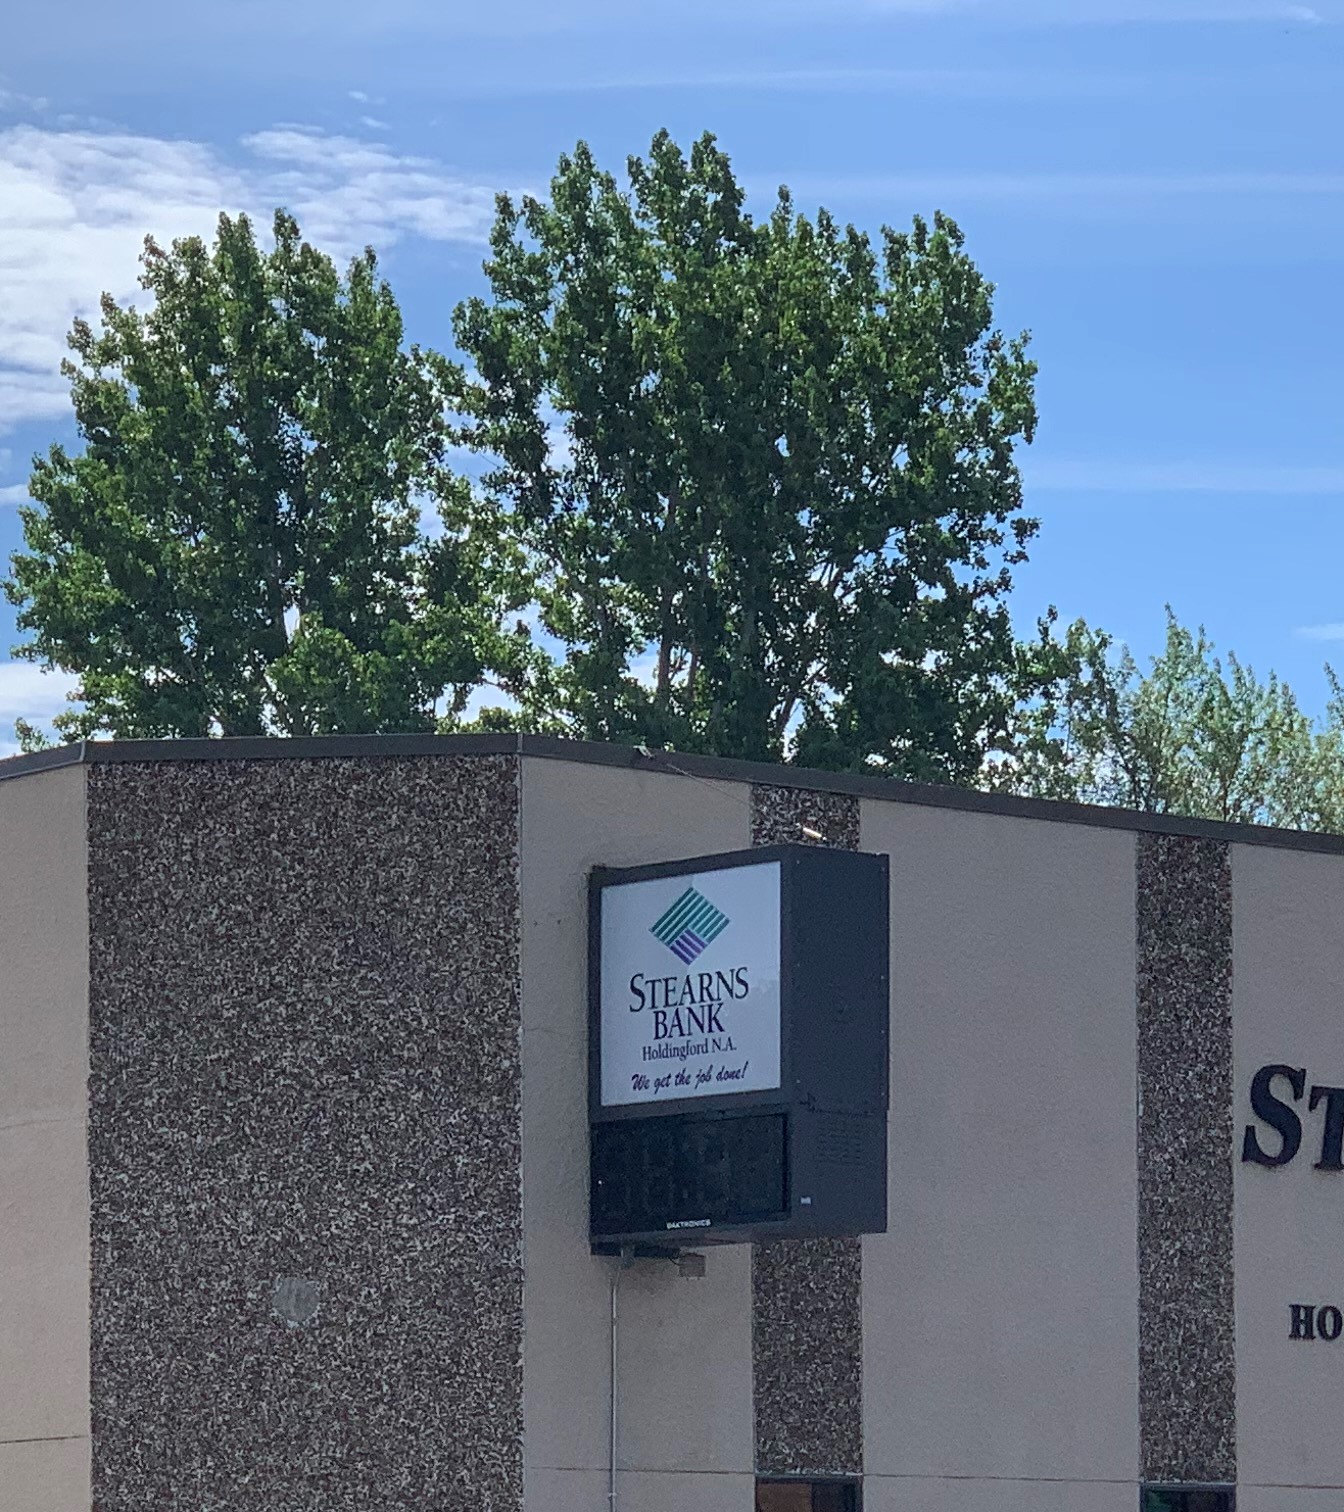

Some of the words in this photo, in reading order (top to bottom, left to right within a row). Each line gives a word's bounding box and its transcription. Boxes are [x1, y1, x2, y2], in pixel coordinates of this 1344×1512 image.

[629, 966, 749, 1013] STEARNS
[653, 1002, 725, 1040] BANK
[642, 1038, 709, 1061] Holdingford
[712, 1036, 737, 1053] N.A.
[631, 1073, 650, 1091] We
[654, 1073, 671, 1095] get
[674, 1067, 691, 1086] the
[694, 1064, 714, 1089] job
[716, 1060, 749, 1082] done!
